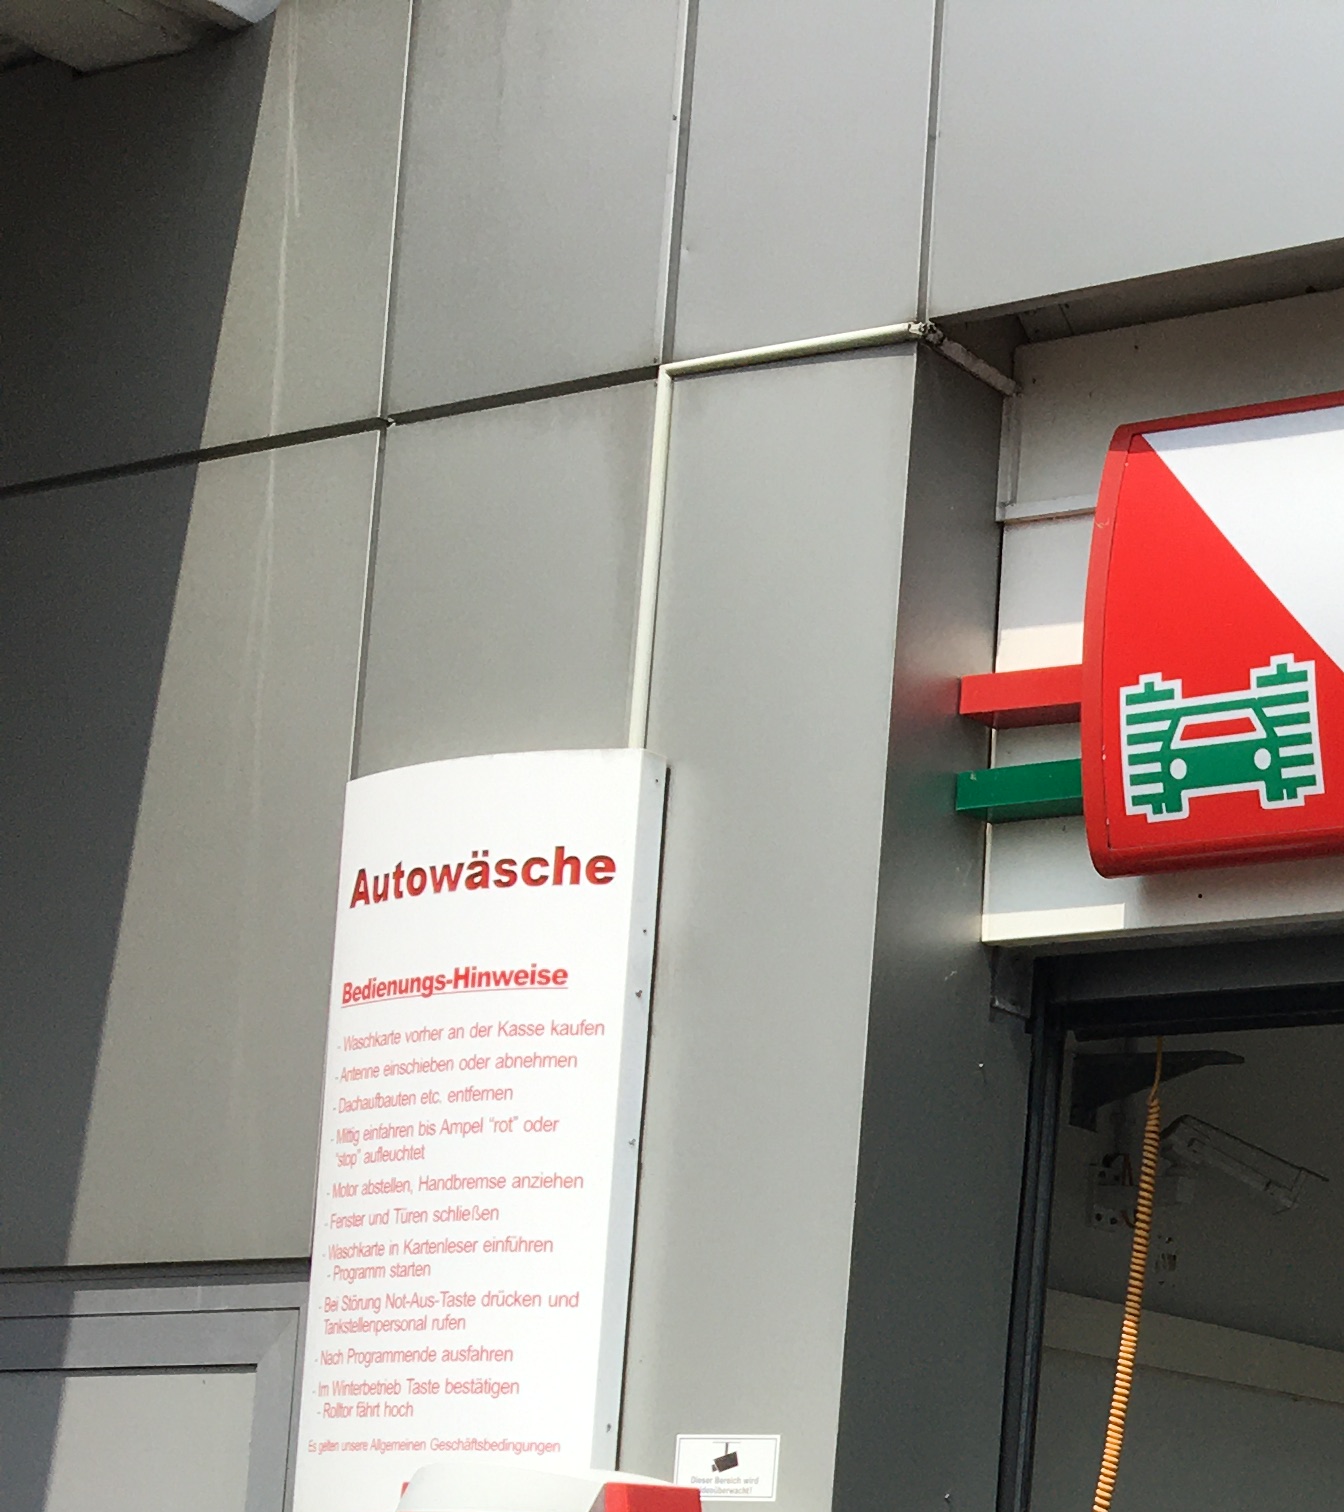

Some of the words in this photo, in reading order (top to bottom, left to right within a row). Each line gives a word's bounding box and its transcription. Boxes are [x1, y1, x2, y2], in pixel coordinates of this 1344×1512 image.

[349, 846, 616, 909] Autowäsche
[341, 963, 568, 1005] Bedienungs-Hinweise
[343, 1030, 401, 1051] Waschkarte
[405, 1025, 444, 1043] vorher
[448, 1026, 464, 1039] an
[469, 1022, 493, 1038] der
[498, 1020, 544, 1037] Kasse
[550, 1018, 605, 1036] kaufen
[340, 1063, 379, 1083] Antenne
[383, 1056, 454, 1078] einschieben
[459, 1053, 490, 1070] oder
[495, 1052, 578, 1069] abnehmen
[338, 1091, 416, 1114] Dachaufbauten
[420, 1089, 442, 1105] etc.
[447, 1085, 513, 1103] entfernen
[336, 1127, 360, 1146] Mittig
[363, 1123, 413, 1141] einfahren
[418, 1120, 436, 1136] bis
[439, 1117, 483, 1138] Ampel
[523, 1116, 559, 1132] oder
[364, 1144, 426, 1164] aufleuchtet
[332, 1180, 358, 1199] Motor
[361, 1177, 413, 1196] abstellen,
[418, 1173, 506, 1192] Handbremse
[511, 1172, 584, 1189] anziehen
[330, 1211, 365, 1230] Fenster
[368, 1209, 389, 1225] und
[394, 1206, 427, 1224] Türen
[432, 1205, 499, 1223] schließen
[328, 1240, 385, 1261] Waschkarte
[389, 1239, 399, 1256] in
[403, 1237, 479, 1255] Kartenleser
[483, 1235, 553, 1253] einführen
[333, 1264, 385, 1284] Programm
[389, 1262, 431, 1278] starten
[324, 1296, 338, 1313] Bei
[341, 1294, 381, 1315] Störung
[385, 1291, 476, 1310] Not-Aus-Taste
[481, 1290, 542, 1308] drücken
[548, 1291, 580, 1308] und
[324, 1314, 427, 1336] Tankstellenpersonal
[431, 1313, 466, 1330] rufen
[320, 1349, 344, 1366] Nach
[347, 1346, 436, 1368] Programmende
[441, 1345, 513, 1362] ausfahren
[318, 1381, 329, 1397] Im
[332, 1379, 401, 1397] Winterbetrieb
[406, 1378, 440, 1395] Taste
[444, 1377, 519, 1399] bestätigen
[323, 1402, 353, 1419] Rolltor
[356, 1400, 380, 1418] fährt
[384, 1401, 413, 1417] hoch
[341, 1439, 368, 1452] unsere
[370, 1438, 426, 1454] Allgemeinen
[430, 1437, 561, 1455] Geschäftsbedingungen
